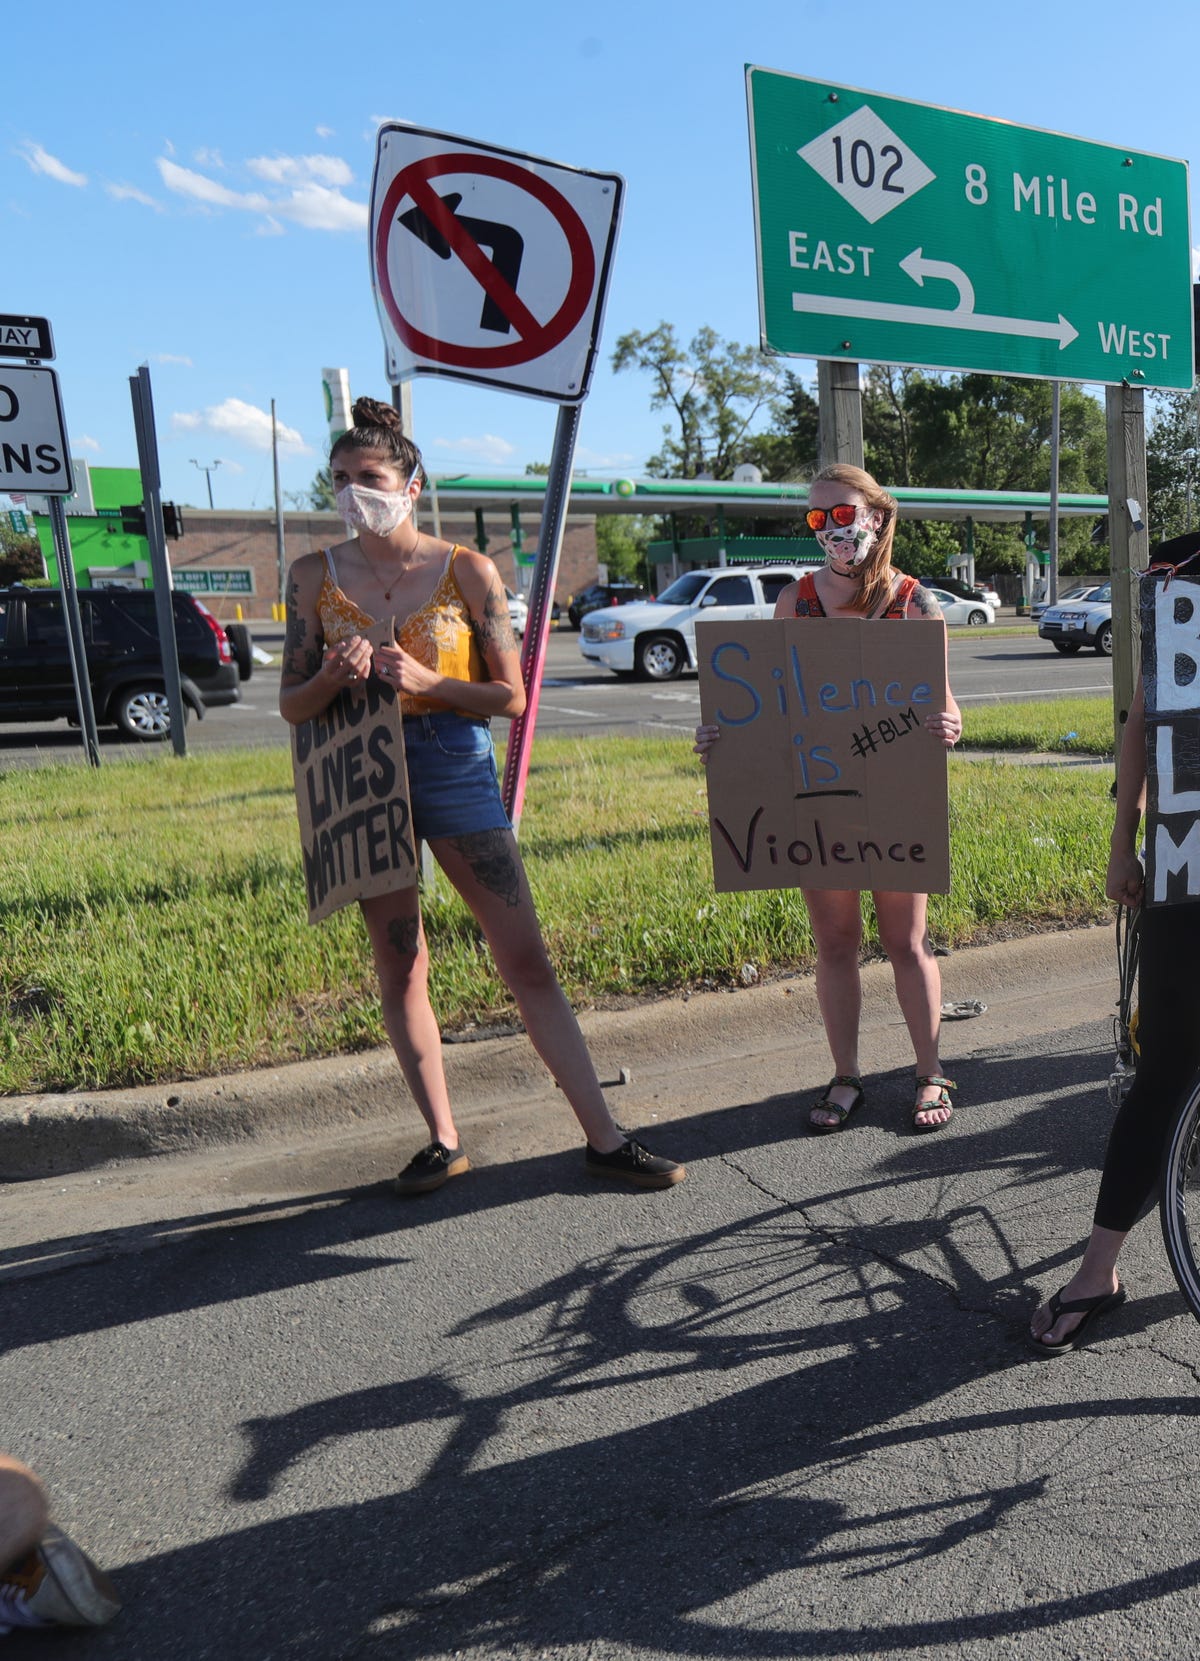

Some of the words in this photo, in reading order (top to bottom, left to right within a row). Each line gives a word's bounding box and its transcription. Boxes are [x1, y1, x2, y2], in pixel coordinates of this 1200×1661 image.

[832, 135, 905, 194] 102
[964, 163, 989, 205] 8
[1012, 172, 1098, 224] Mile
[1118, 192, 1164, 237] Rd
[788, 230, 875, 277] EAST
[0, 327, 32, 345] AY
[1098, 321, 1171, 360] WEST
[0, 443, 62, 475] NS
[710, 641, 934, 728] Silence
[850, 706, 921, 759] #BLM
[305, 724, 396, 830] LIVES
[792, 733, 841, 790] is
[303, 796, 415, 912] MATTER
[714, 805, 927, 874] Violence
